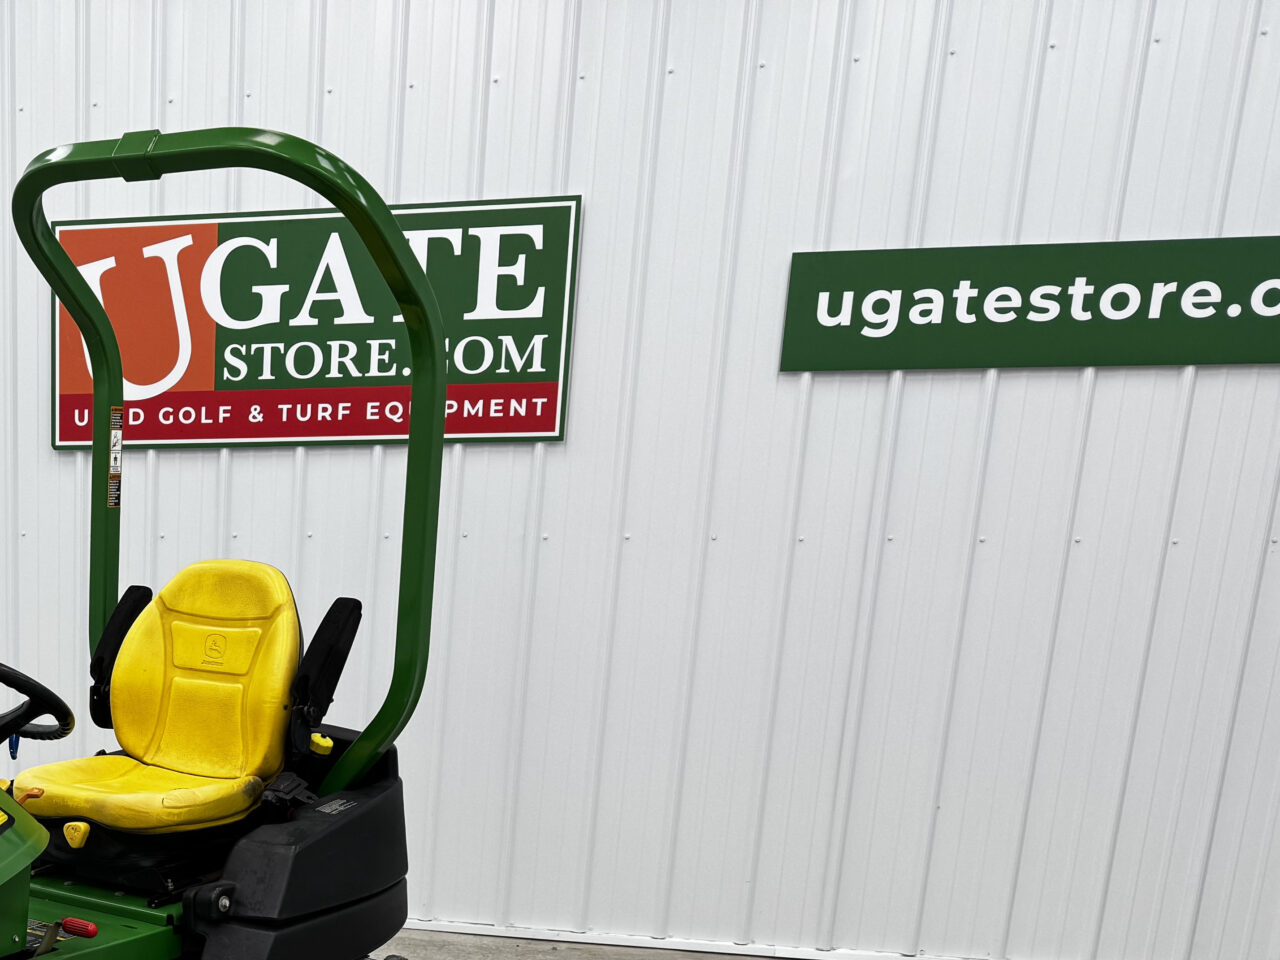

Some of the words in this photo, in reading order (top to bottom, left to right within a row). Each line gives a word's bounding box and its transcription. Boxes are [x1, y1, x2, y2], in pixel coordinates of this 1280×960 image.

[815, 276, 1280, 338] ugatestore.c
[222, 334, 548, 382] STORE.OM
[73, 407, 145, 427] UD
[158, 405, 232, 425] GOLF
[248, 404, 264, 423] &
[277, 402, 352, 423] TURF
[365, 398, 548, 423] EQPMENT
